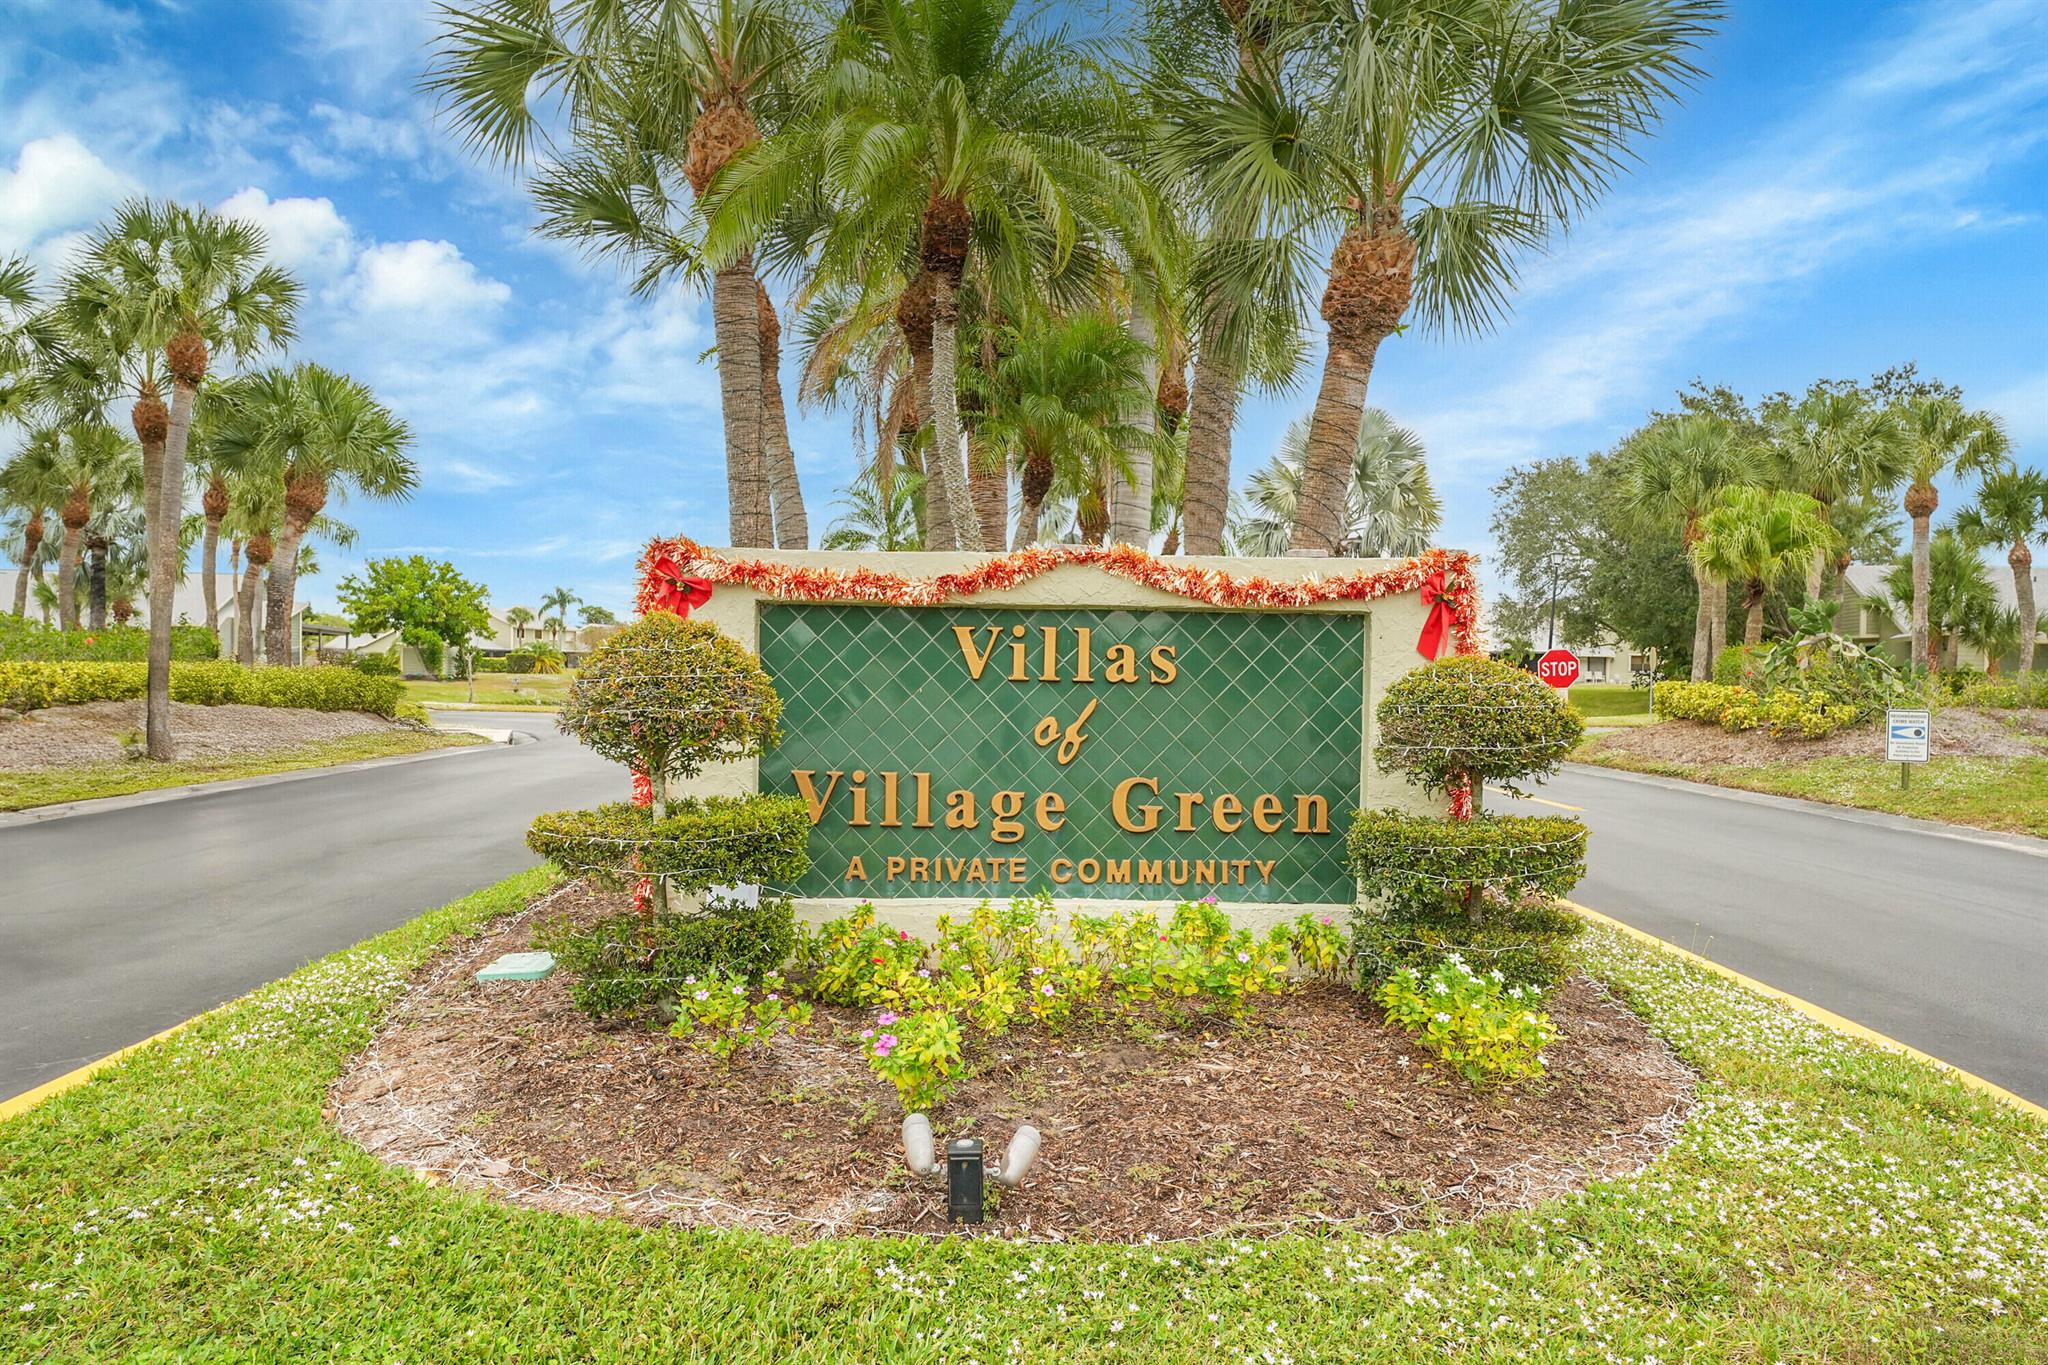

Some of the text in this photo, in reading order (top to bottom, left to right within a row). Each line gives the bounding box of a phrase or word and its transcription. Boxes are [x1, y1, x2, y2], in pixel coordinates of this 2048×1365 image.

[952, 624, 1177, 685] Villas
[1541, 661, 1577, 677] STOP
[1034, 697, 1098, 765] of
[791, 769, 1331, 844] Village Green
[844, 855, 1276, 885] A PRIVATE COMMUNITY
